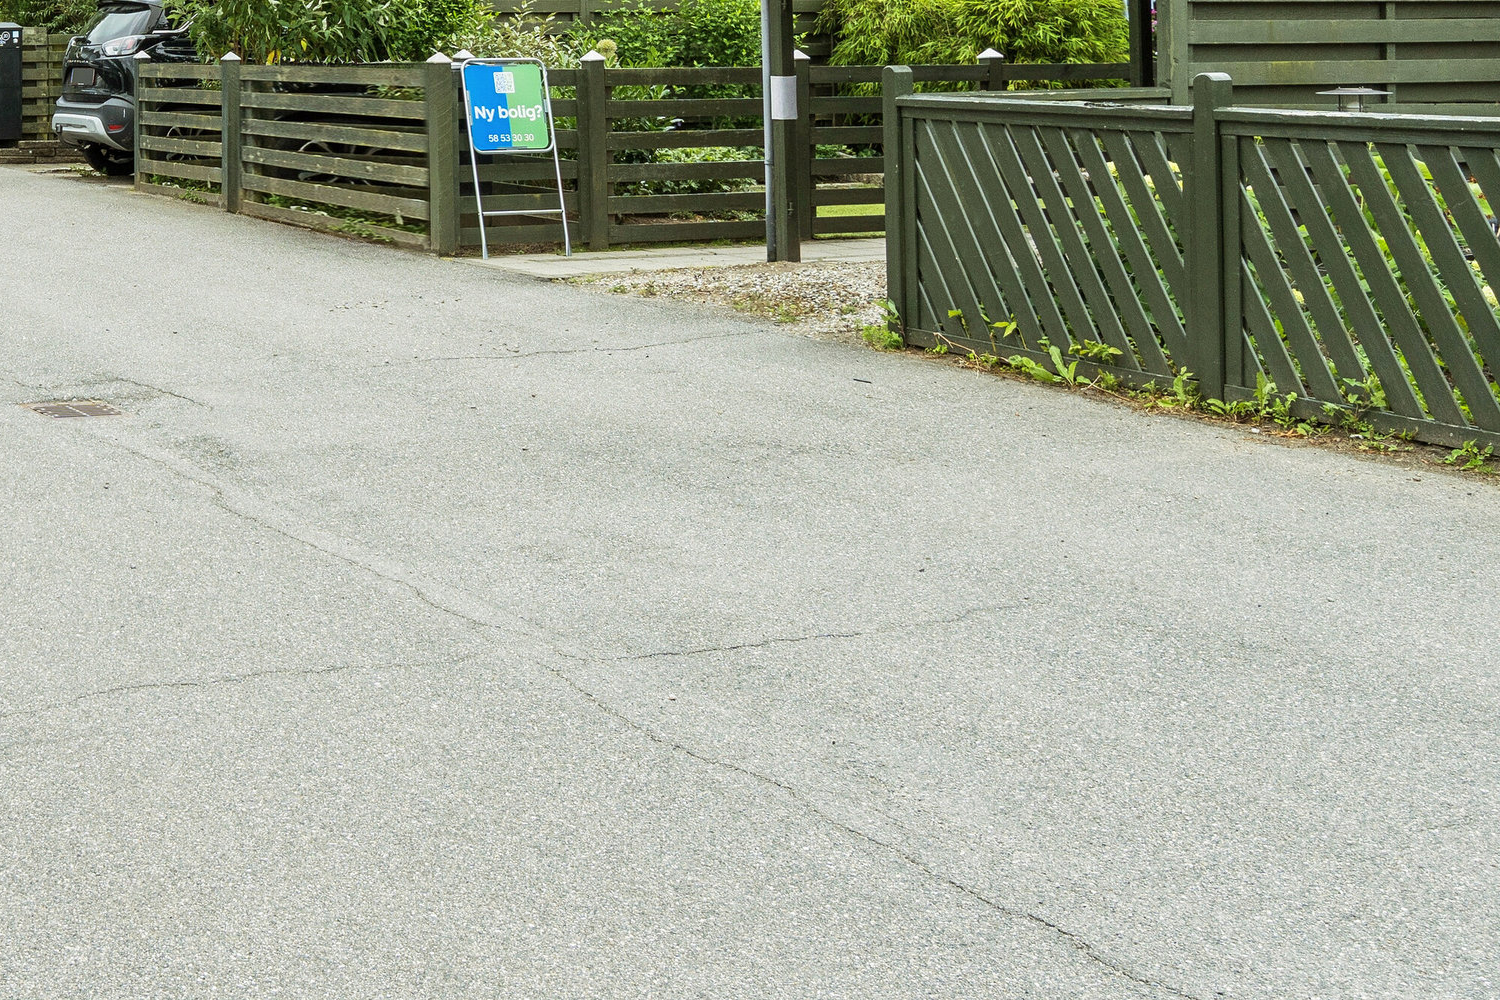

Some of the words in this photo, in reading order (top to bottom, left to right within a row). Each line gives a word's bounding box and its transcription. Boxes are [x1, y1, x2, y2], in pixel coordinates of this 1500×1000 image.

[474, 105, 495, 122] Ny
[498, 105, 542, 121] bolig?
[488, 134, 499, 142] 58
[500, 134, 511, 142] 53
[524, 133, 534, 141] 30
